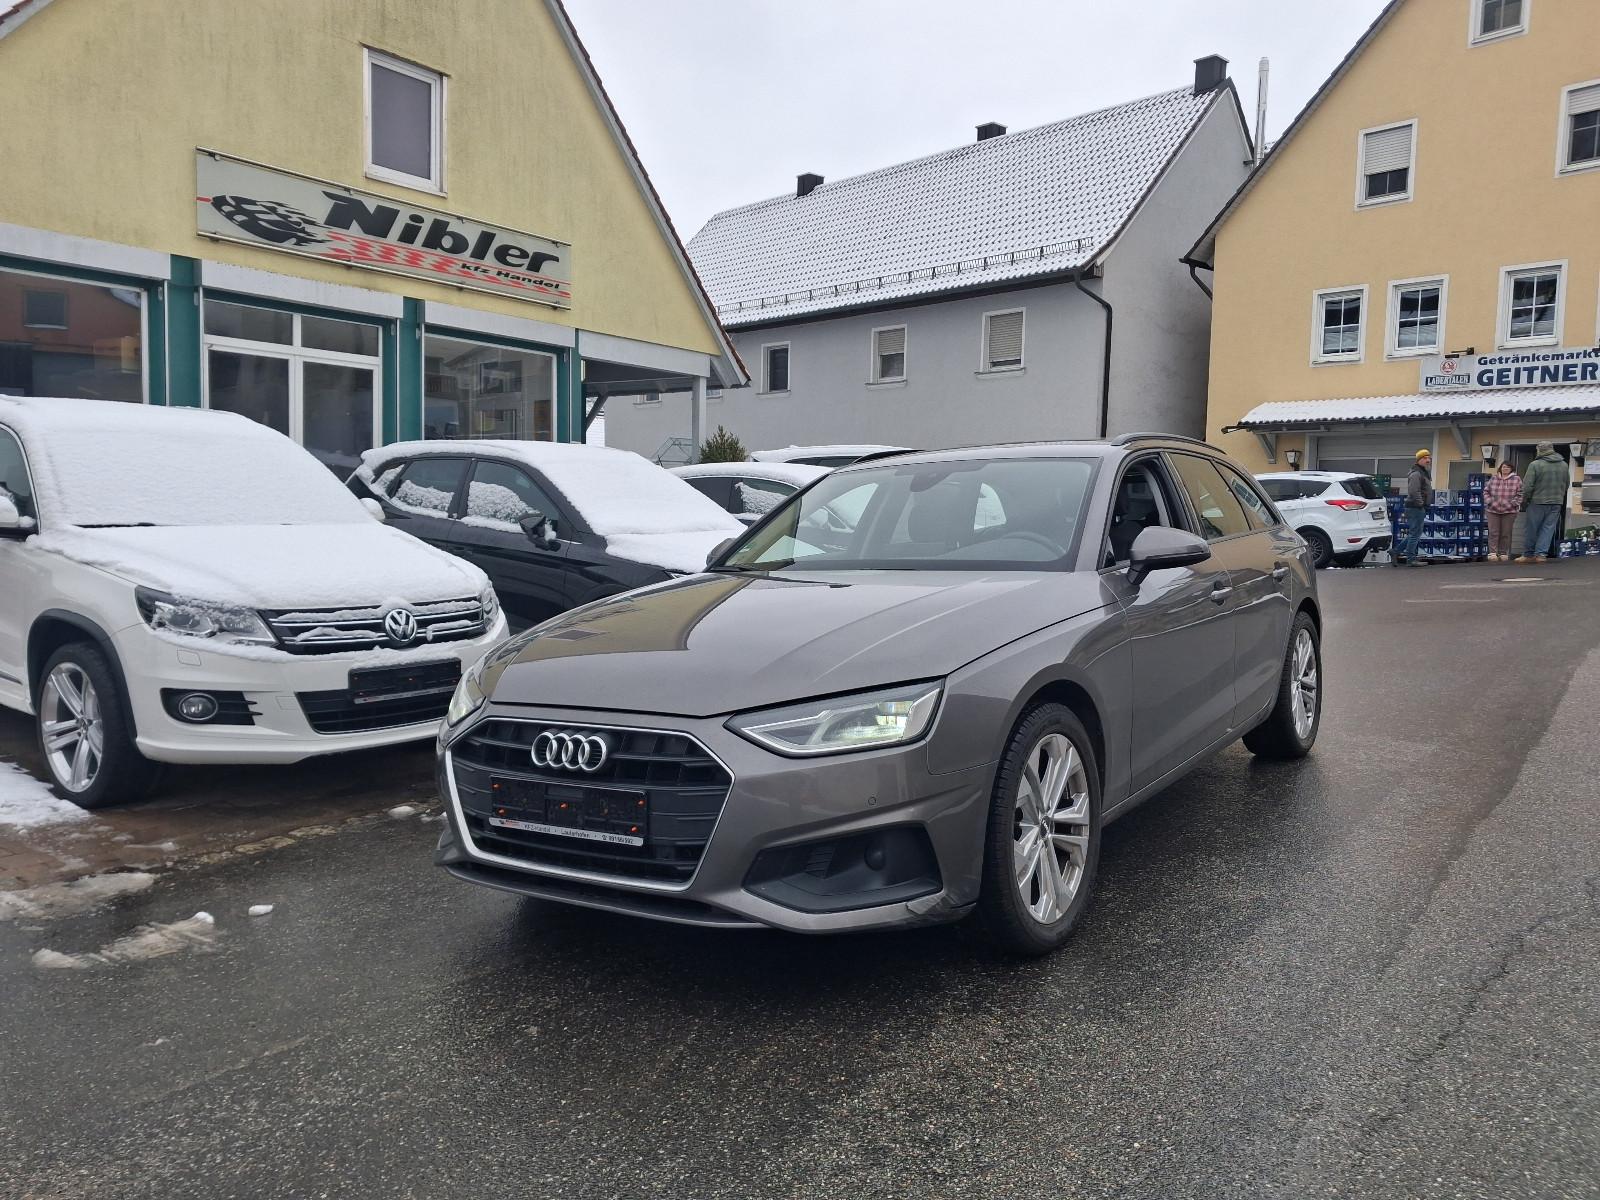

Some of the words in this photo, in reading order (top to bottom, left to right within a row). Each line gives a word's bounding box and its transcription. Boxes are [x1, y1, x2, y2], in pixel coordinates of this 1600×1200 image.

[321, 190, 560, 273] Nibler
[496, 271, 560, 289] Handel
[1477, 362, 1599, 387] GEITNER
